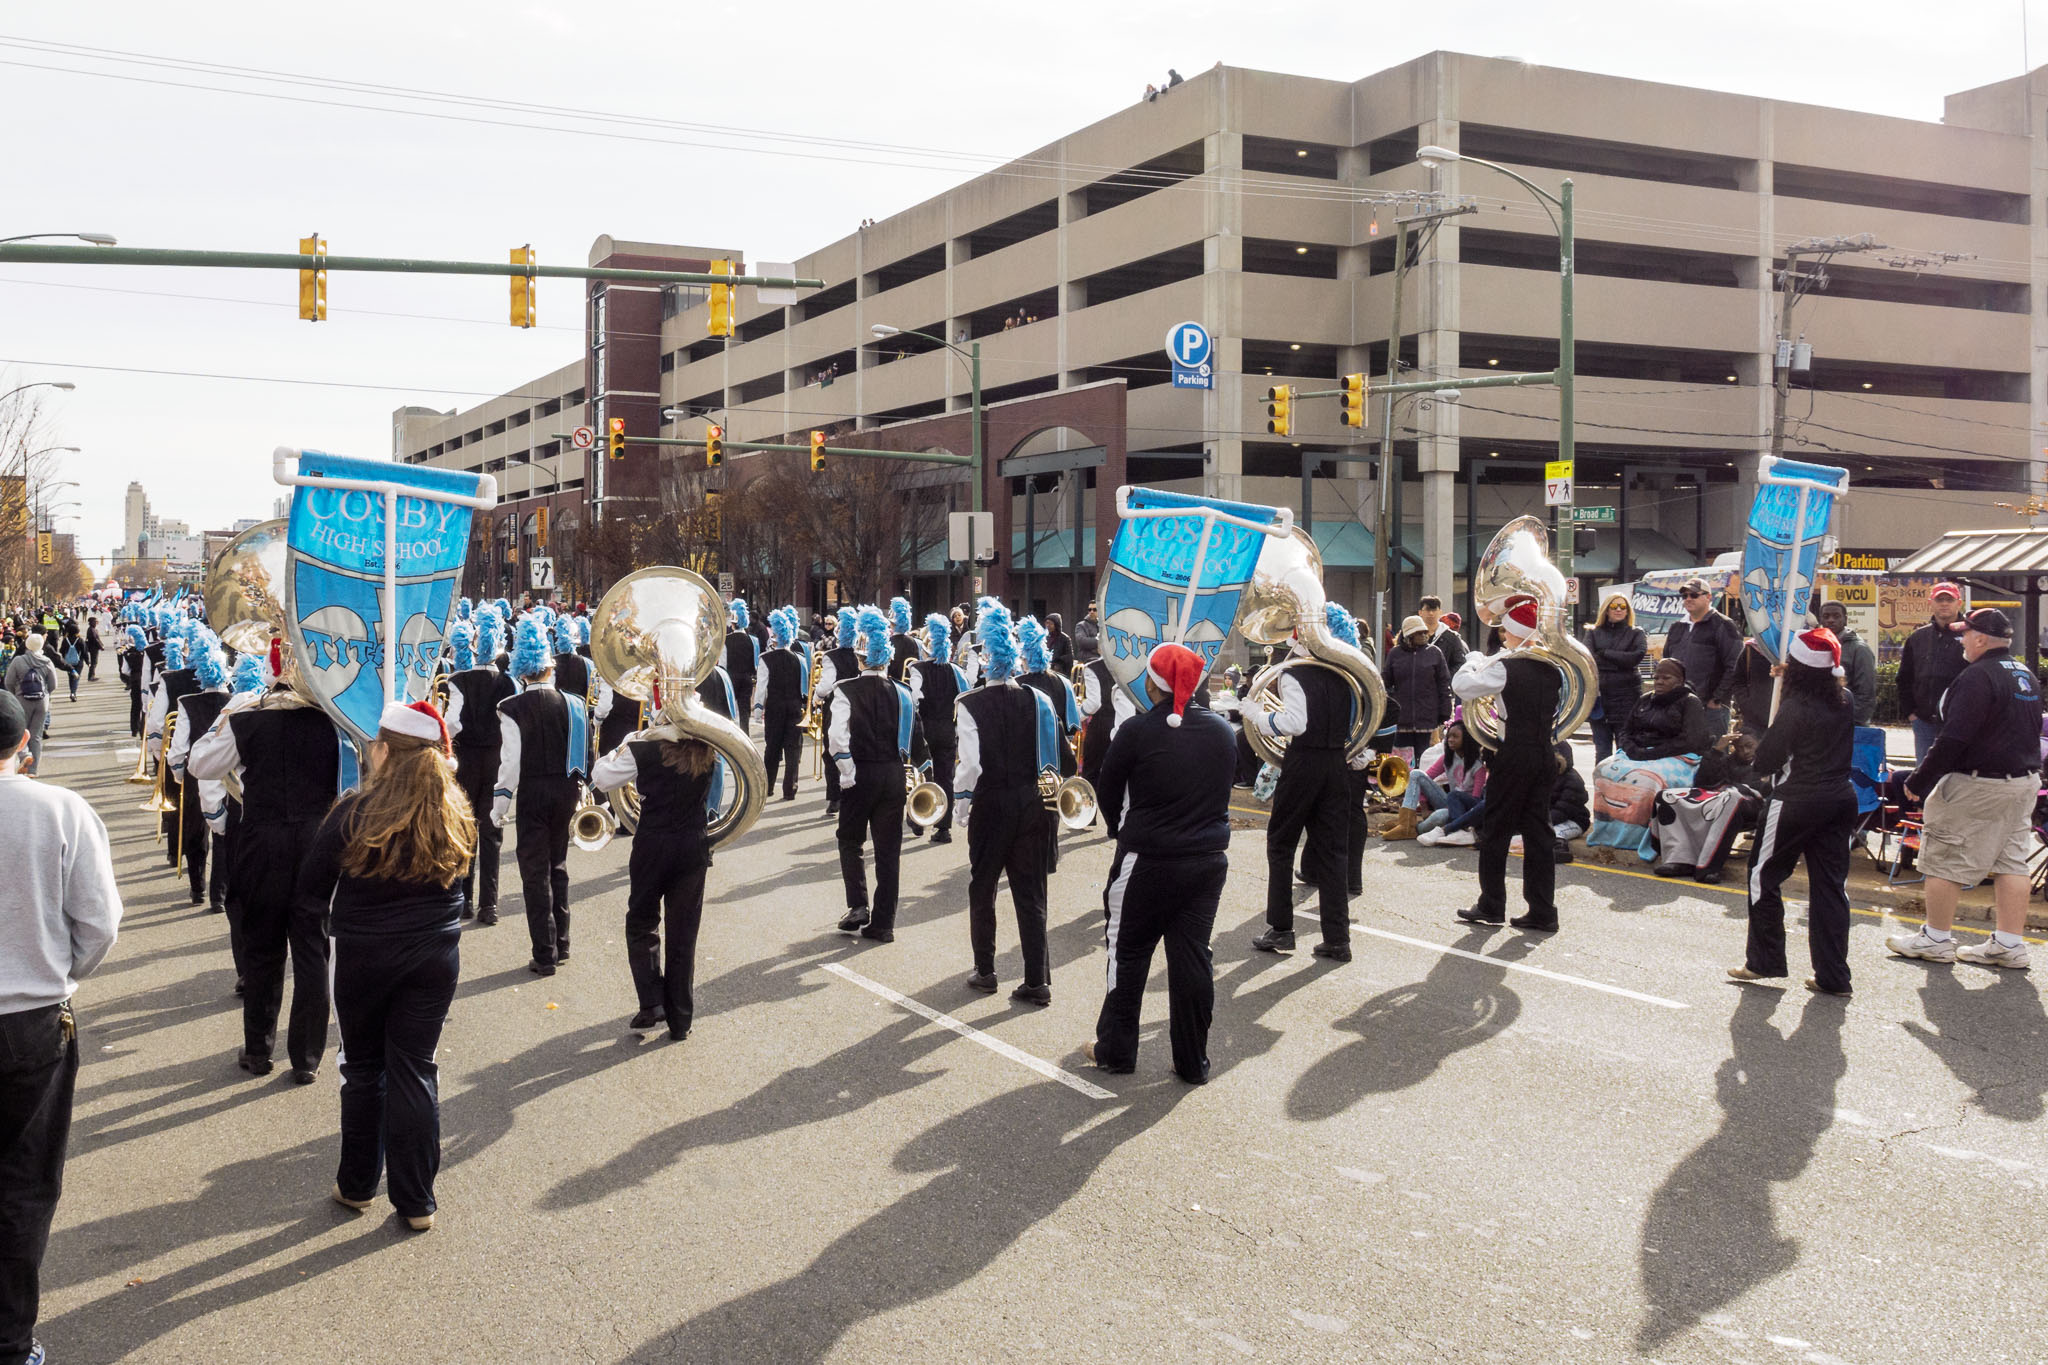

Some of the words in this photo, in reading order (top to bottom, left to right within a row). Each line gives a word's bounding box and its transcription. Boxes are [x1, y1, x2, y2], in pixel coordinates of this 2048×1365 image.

[1182, 328, 1204, 360] P
[1178, 374, 1209, 388] Parking
[1579, 508, 1599, 519] Broad
[310, 521, 366, 556] HIGH
[372, 536, 450, 560] SHOOL
[41, 543, 49, 563] VCU
[1843, 552, 1886, 571] Parking
[364, 559, 380, 569] Est.
[1170, 555, 1240, 575] SCOOL
[720, 582, 732, 590] 25
[1845, 588, 1868, 601] VCU
[301, 627, 443, 679] TITANS
